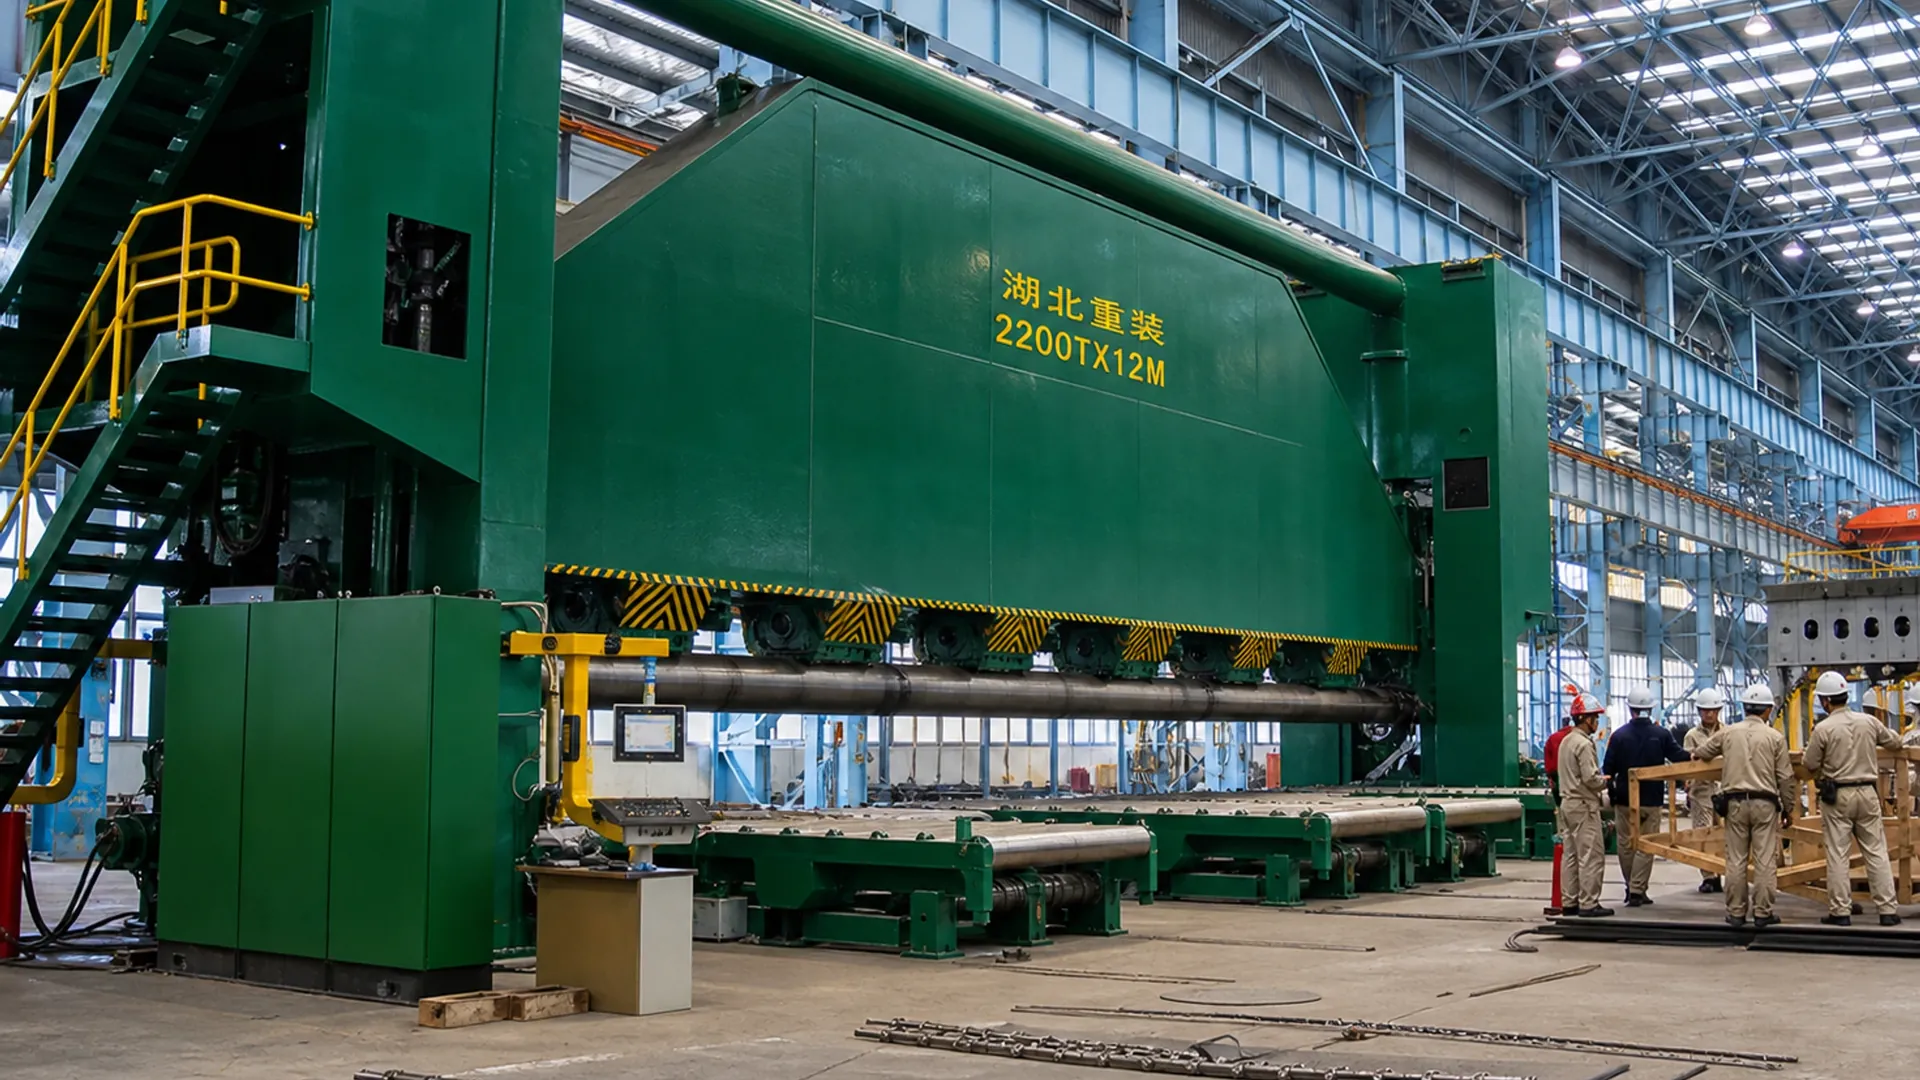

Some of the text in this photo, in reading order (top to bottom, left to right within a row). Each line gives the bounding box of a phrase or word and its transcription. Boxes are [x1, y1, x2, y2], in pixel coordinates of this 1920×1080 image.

[1002, 268, 1165, 346] 湖北重装
[994, 313, 1165, 387] 2200TX12M
